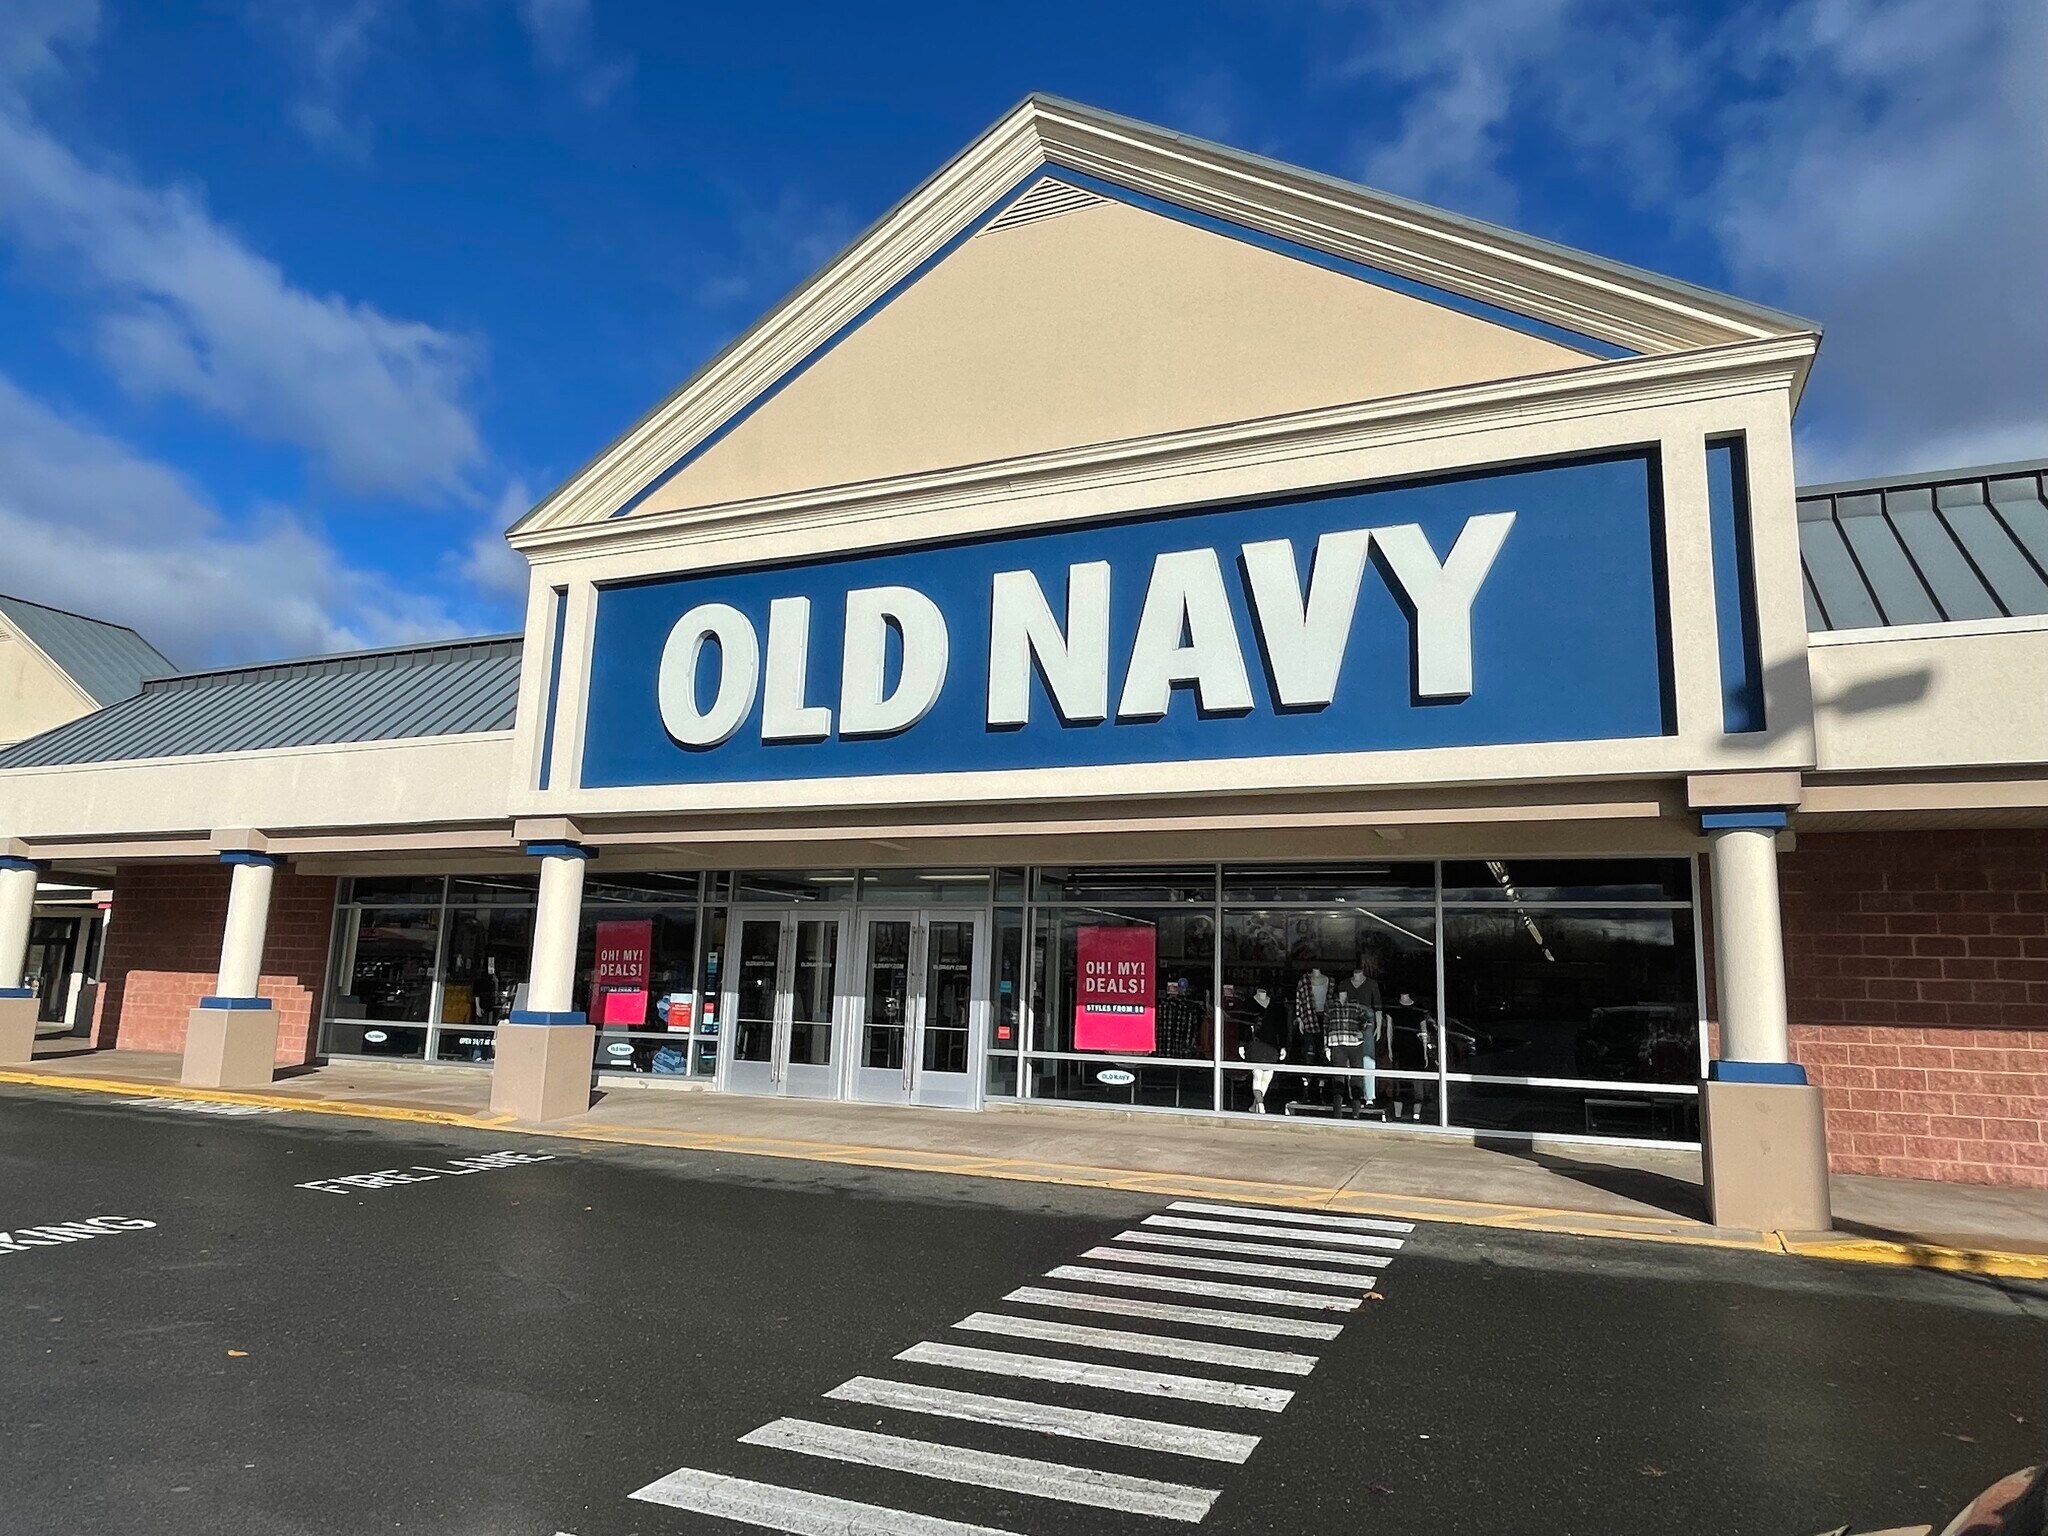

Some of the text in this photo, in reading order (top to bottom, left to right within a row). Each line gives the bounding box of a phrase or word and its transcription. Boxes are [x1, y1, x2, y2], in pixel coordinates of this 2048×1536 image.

[657, 511, 1516, 748] OLD NAVY
[601, 949, 643, 961] OH! MY!
[600, 963, 643, 977] DEALS!
[1086, 961, 1145, 976] OH! MY!
[1086, 977, 1145, 994] DEALS!
[1086, 1004, 1111, 1012] STYLES
[1112, 1005, 1133, 1013] FROM
[293, 1150, 556, 1195] FIRE LANE
[0, 1214, 157, 1255] KING
